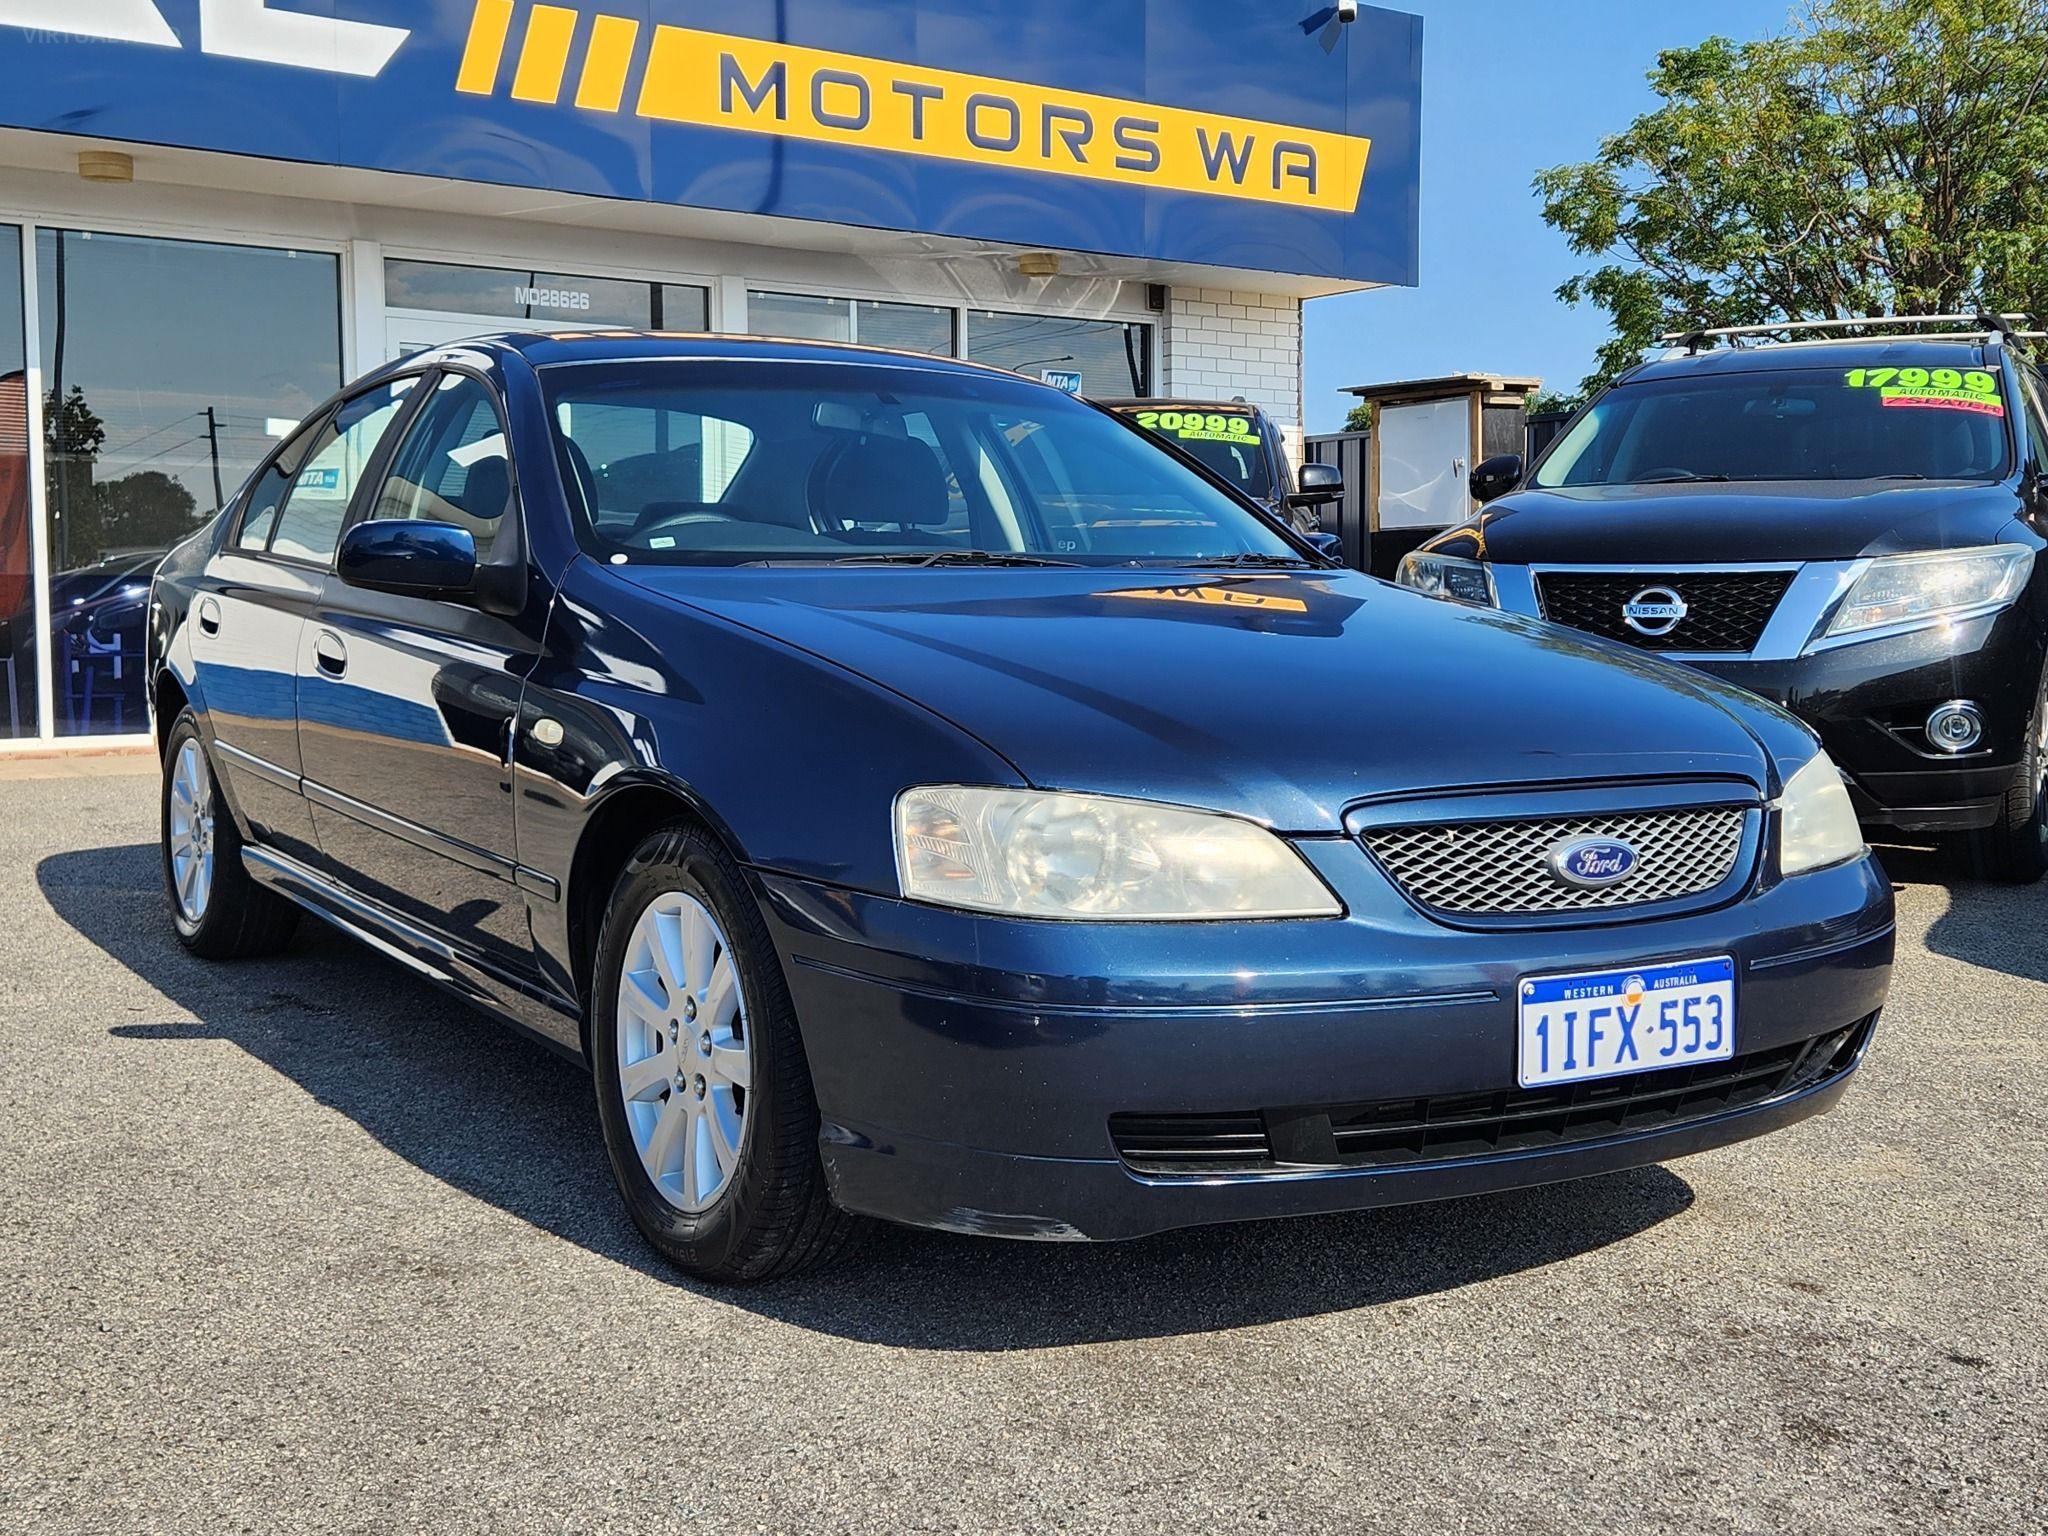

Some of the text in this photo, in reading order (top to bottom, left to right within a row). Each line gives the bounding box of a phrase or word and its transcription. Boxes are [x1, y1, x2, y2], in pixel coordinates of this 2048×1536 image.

[719, 52, 1319, 195] MOTORS WA
[1046, 374, 1068, 390] MTA
[1844, 367, 1996, 394] 17999
[1897, 387, 1986, 401] AUTOMATIC
[1906, 397, 2001, 414] SEATER
[1136, 412, 1249, 435] 20999
[1190, 430, 1248, 442] AUTOMATIC
[1628, 606, 1679, 616] NISSAN
[1576, 847, 1624, 876] Ford
[1563, 974, 1698, 1000] WESTERN AUSTRALIA
